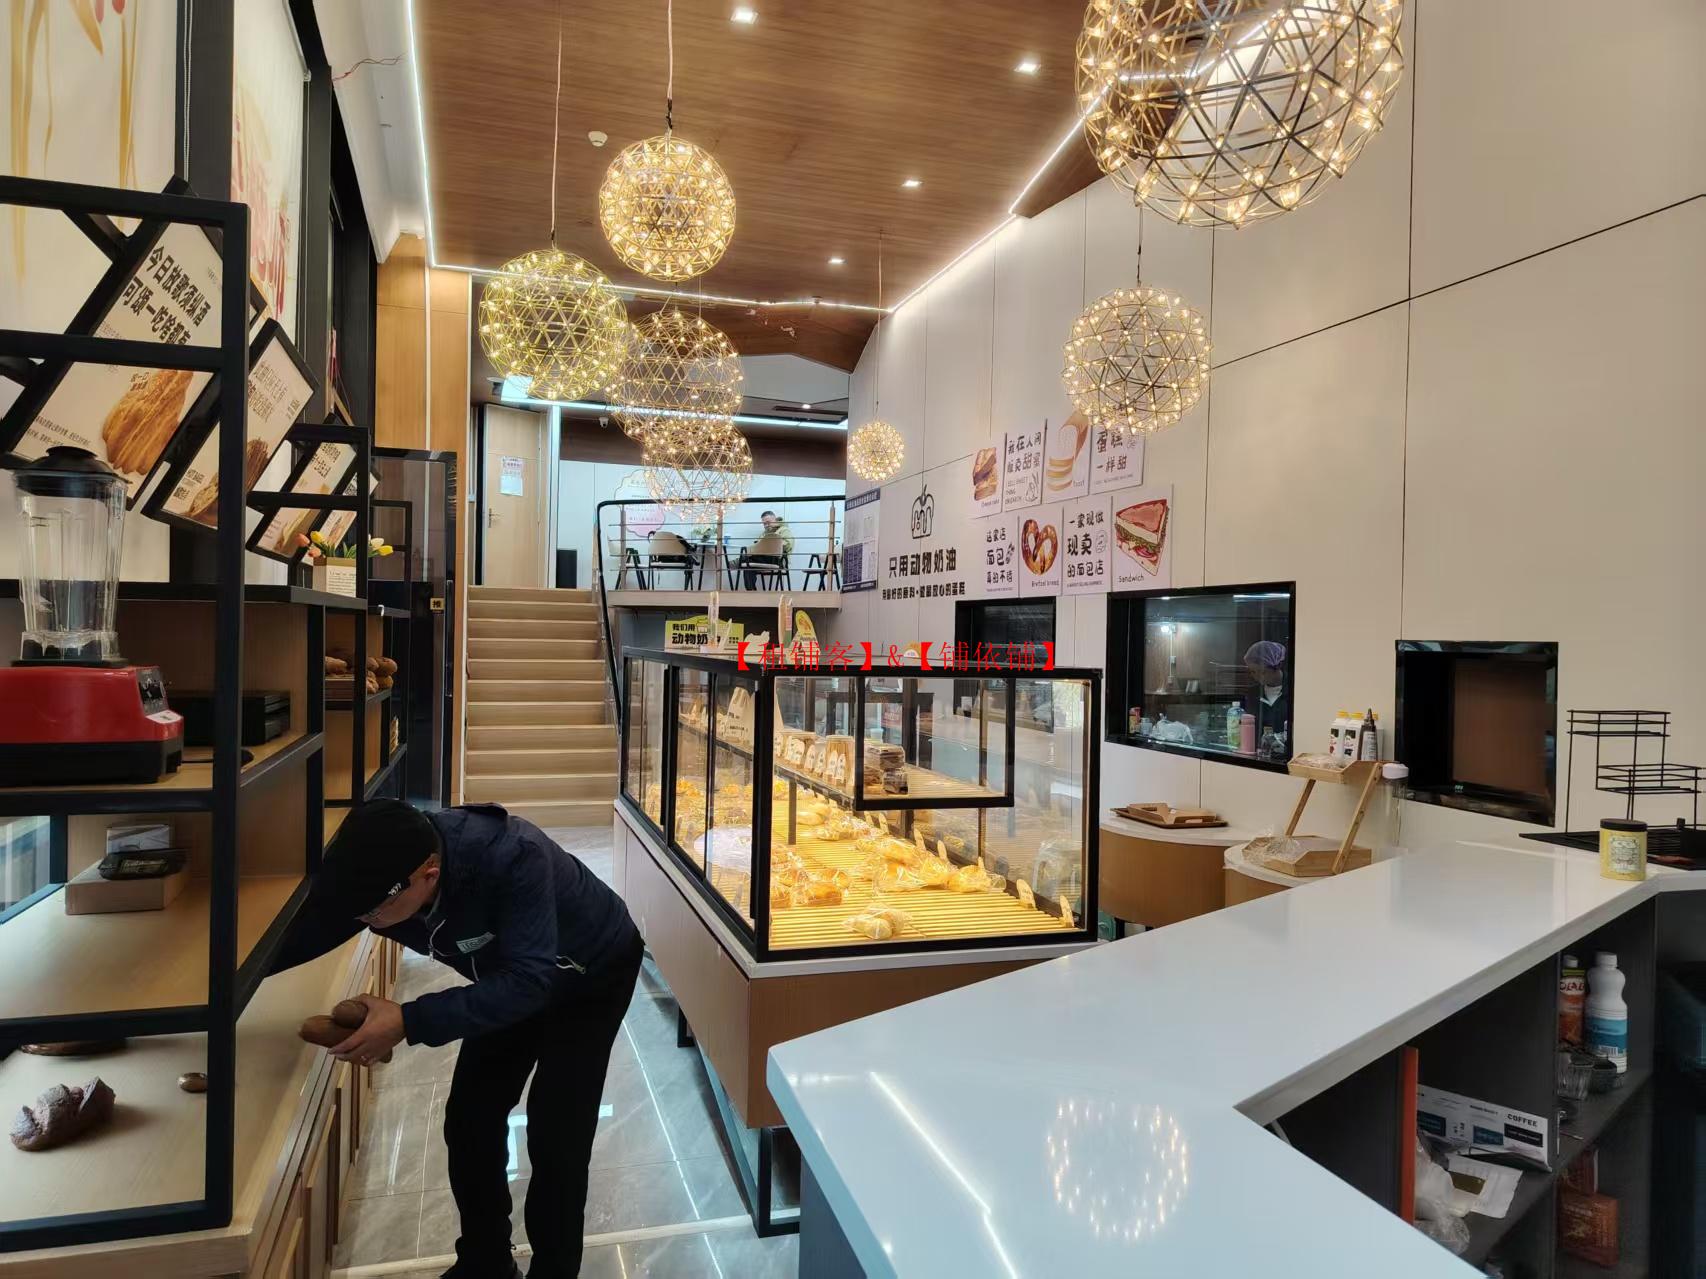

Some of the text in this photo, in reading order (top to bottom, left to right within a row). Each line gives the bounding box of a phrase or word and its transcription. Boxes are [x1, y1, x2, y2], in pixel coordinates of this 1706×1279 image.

[146, 245, 211, 327] 今日放歌须纵酒
[1096, 454, 1127, 473] 一样甜
[1067, 533, 1092, 556] 现卖
[889, 547, 956, 579] 只用动物奶油
[986, 548, 1005, 566] 面包
[1067, 560, 1104, 577] 的面包店
[672, 633, 720, 645] 动物奶
[1507, 1113, 1538, 1127] COFFEE
